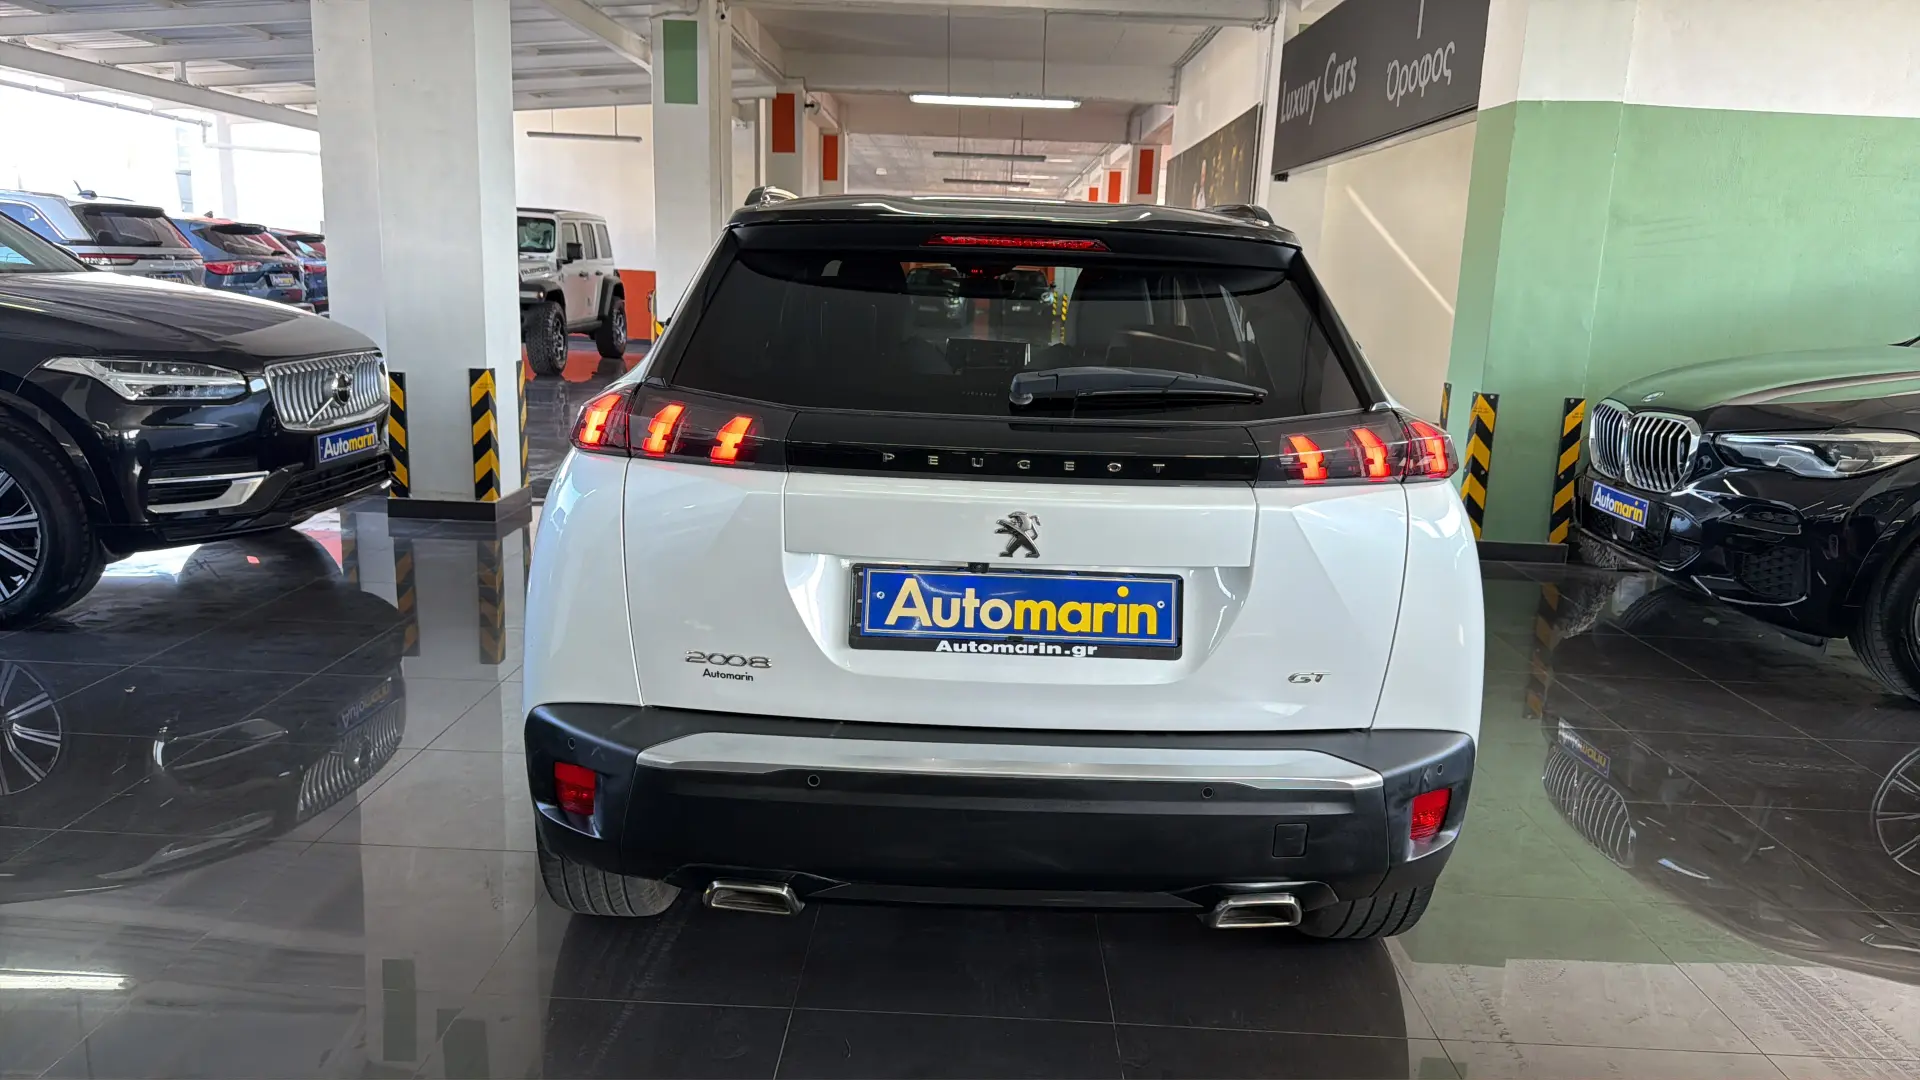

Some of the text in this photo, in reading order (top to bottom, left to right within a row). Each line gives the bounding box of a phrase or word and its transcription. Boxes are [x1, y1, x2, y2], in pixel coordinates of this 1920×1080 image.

[1280, 52, 1358, 125] Luxury Cars
[323, 427, 375, 459] Automarin
[882, 452, 1165, 474] PEUGEOT
[1593, 486, 1643, 523] Automarin
[884, 577, 1157, 635] Automarin
[685, 650, 773, 668] 2008
[936, 639, 1098, 657] Automarin.gr
[702, 668, 754, 681] Automarin
[1287, 671, 1331, 684] GT
